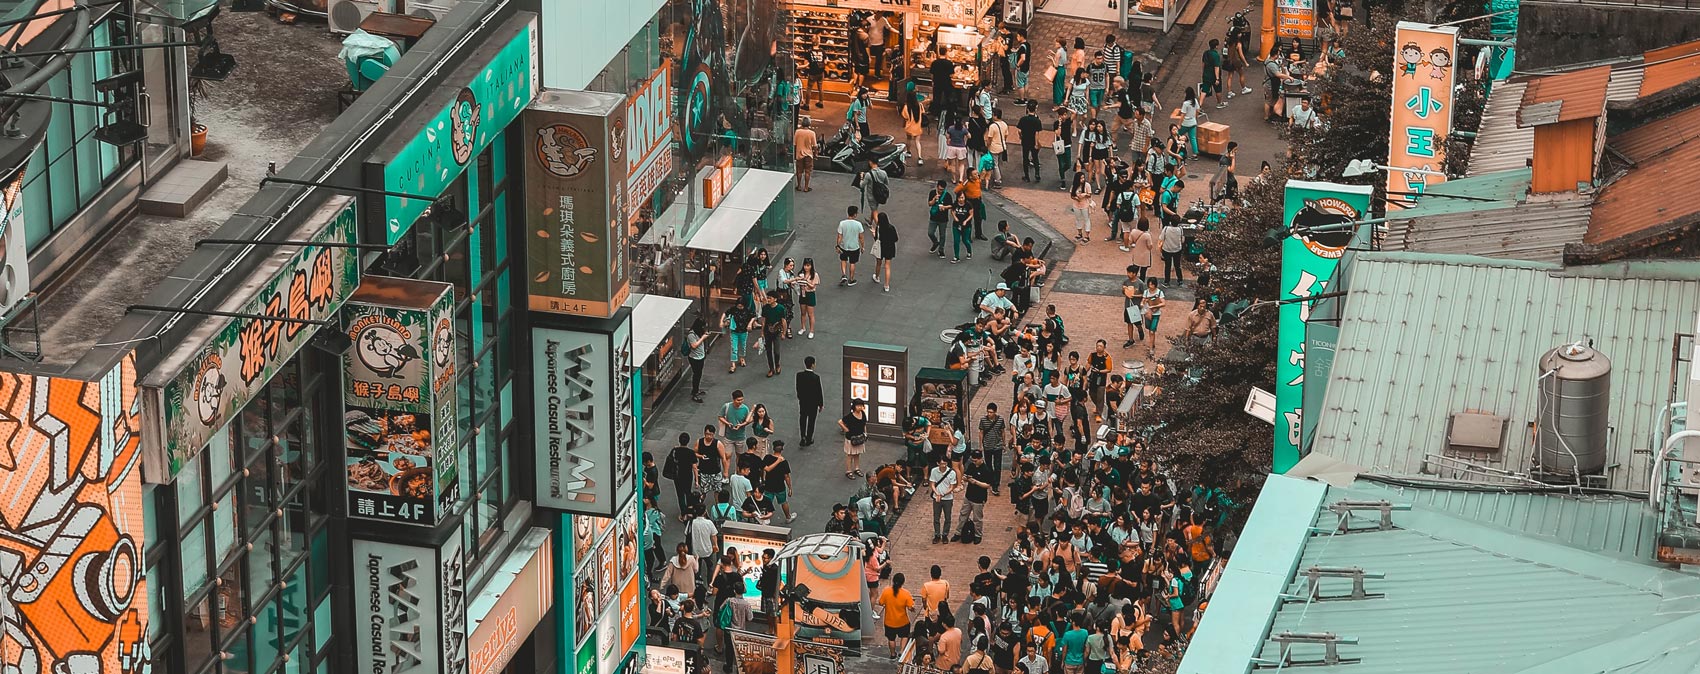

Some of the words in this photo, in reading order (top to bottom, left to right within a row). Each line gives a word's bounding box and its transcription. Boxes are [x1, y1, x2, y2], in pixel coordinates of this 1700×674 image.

[400, 140, 441, 189] CUCINA
[486, 54, 525, 99] ITALIANA
[1319, 199, 1356, 219] HOWARD
[559, 195, 577, 296] 瑪琪朵義式廚房
[240, 246, 334, 388] 猴子島嶼
[550, 301, 588, 313] 請上4F
[349, 314, 380, 341] MONKEY
[382, 315, 412, 340] ISLAND
[545, 339, 561, 395] Japanese
[353, 379, 420, 403] 猴子島嶼
[548, 396, 562, 435] Casual
[563, 343, 597, 503] WATAMI
[357, 498, 425, 520] 請上4F
[368, 553, 382, 613] Japanese
[371, 614, 386, 654] Casual
[826, 612, 846, 629] LIFE
